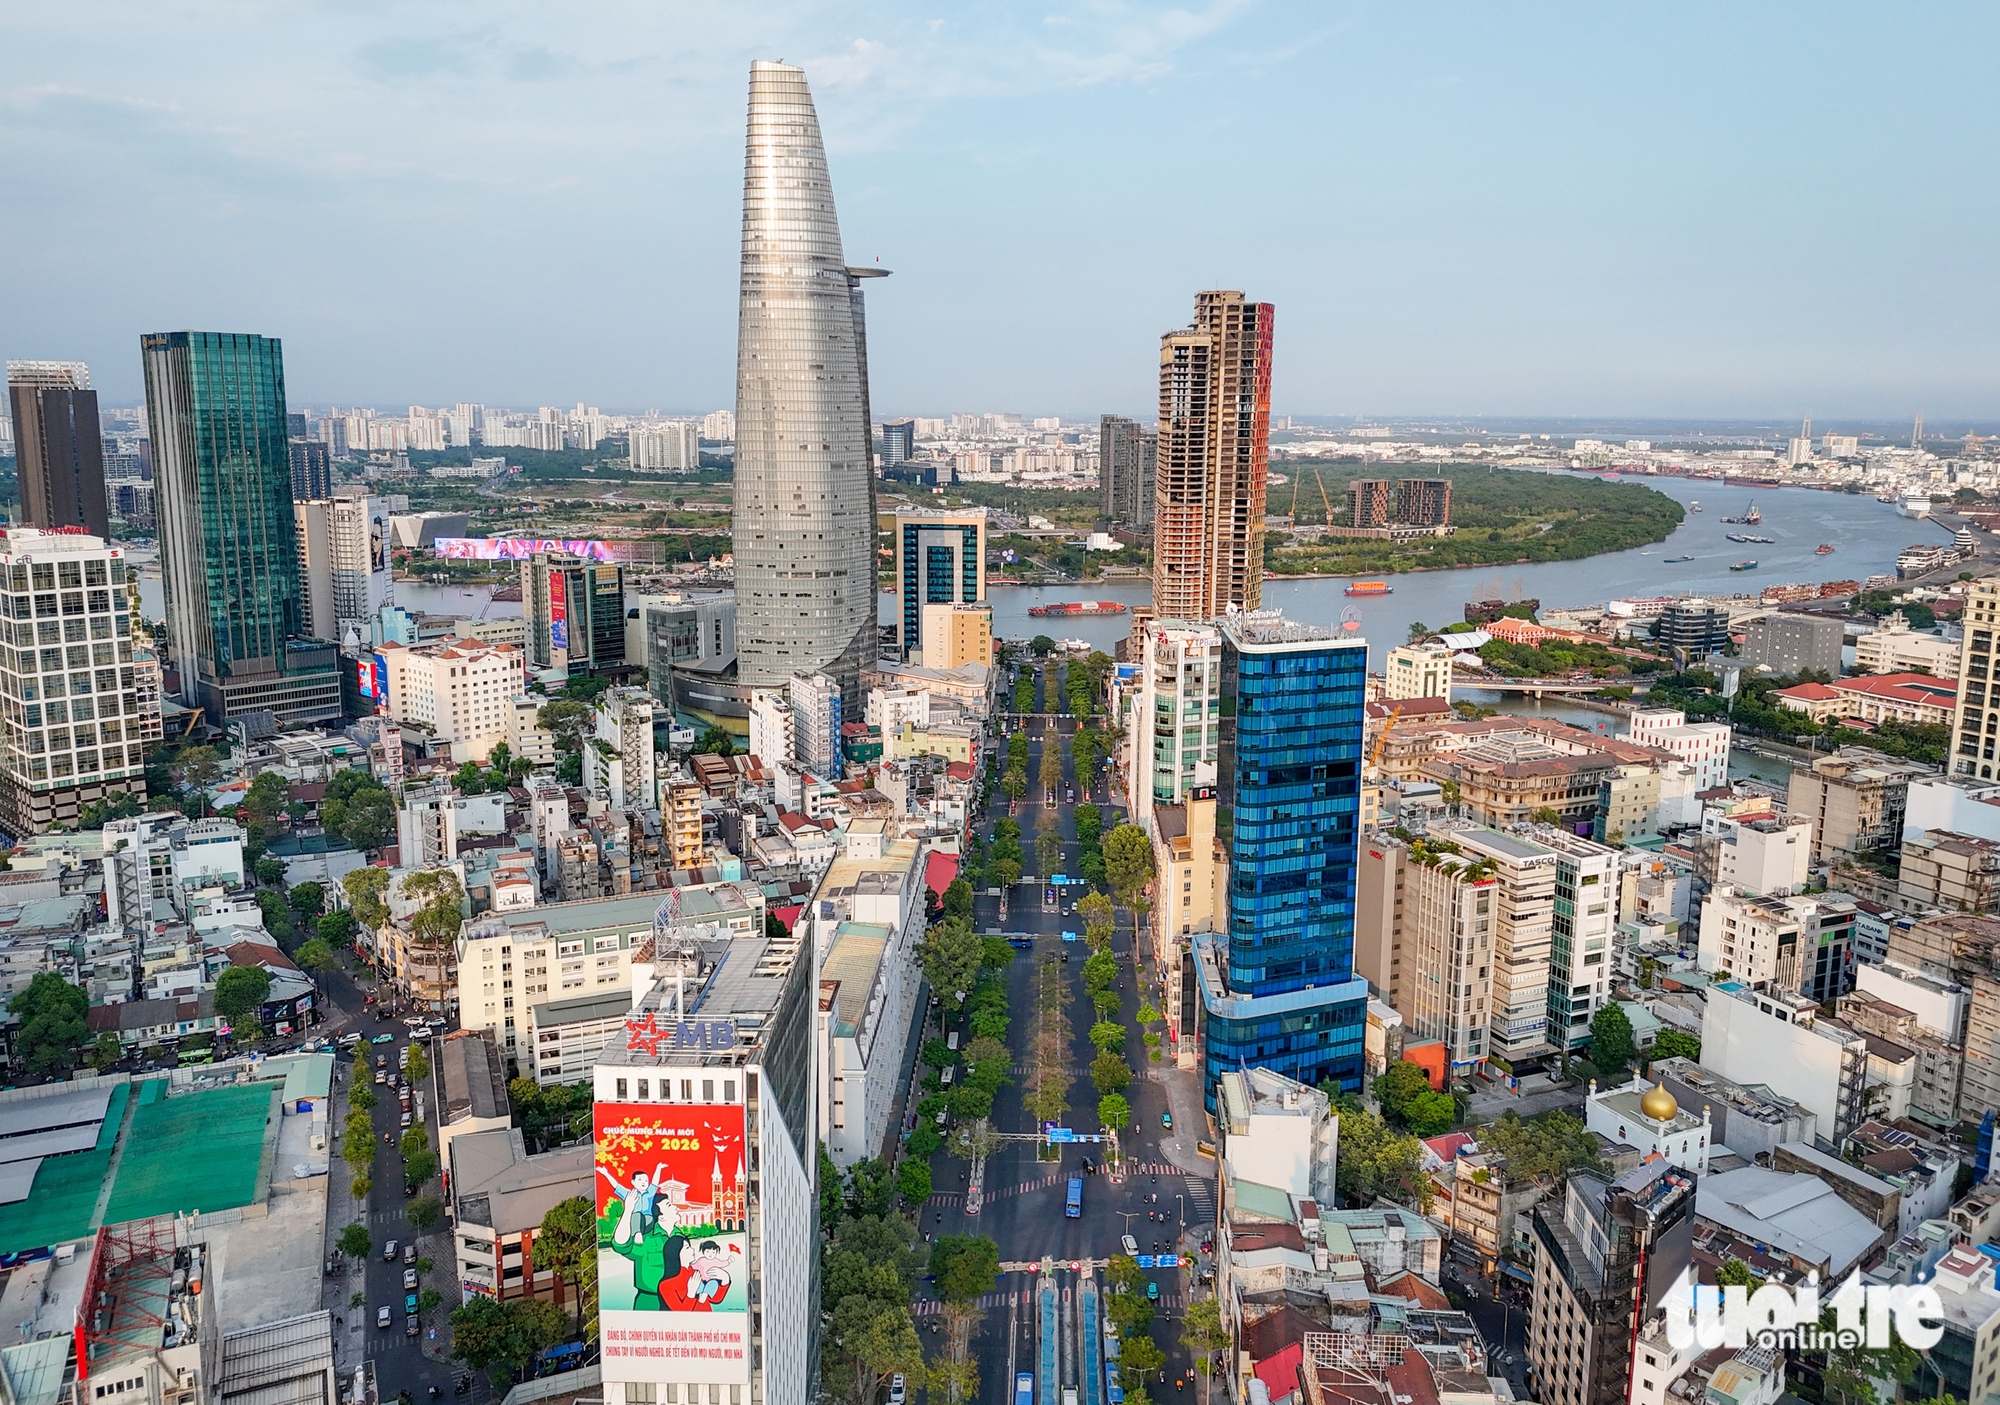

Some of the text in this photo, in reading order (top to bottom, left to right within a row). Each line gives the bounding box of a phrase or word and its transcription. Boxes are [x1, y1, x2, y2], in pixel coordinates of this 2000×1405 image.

[15, 554, 33, 565] citi
[1522, 857, 1555, 868] TASCO
[675, 1021, 735, 1050] MB
[1525, 1049, 1549, 1059] TASCO
[602, 1126, 624, 1134] CHÚC
[677, 1127, 695, 1136] MỚI
[661, 1138, 700, 1151] 2026
[629, 1329, 642, 1341] CHÍNH
[703, 1329, 712, 1342] PHỐ
[720, 1331, 728, 1343] CHÍ
[729, 1333, 741, 1343] MINH
[606, 1346, 620, 1357] CHUNG
[621, 1346, 629, 1357] TAY
[672, 1344, 680, 1357] TẾT
